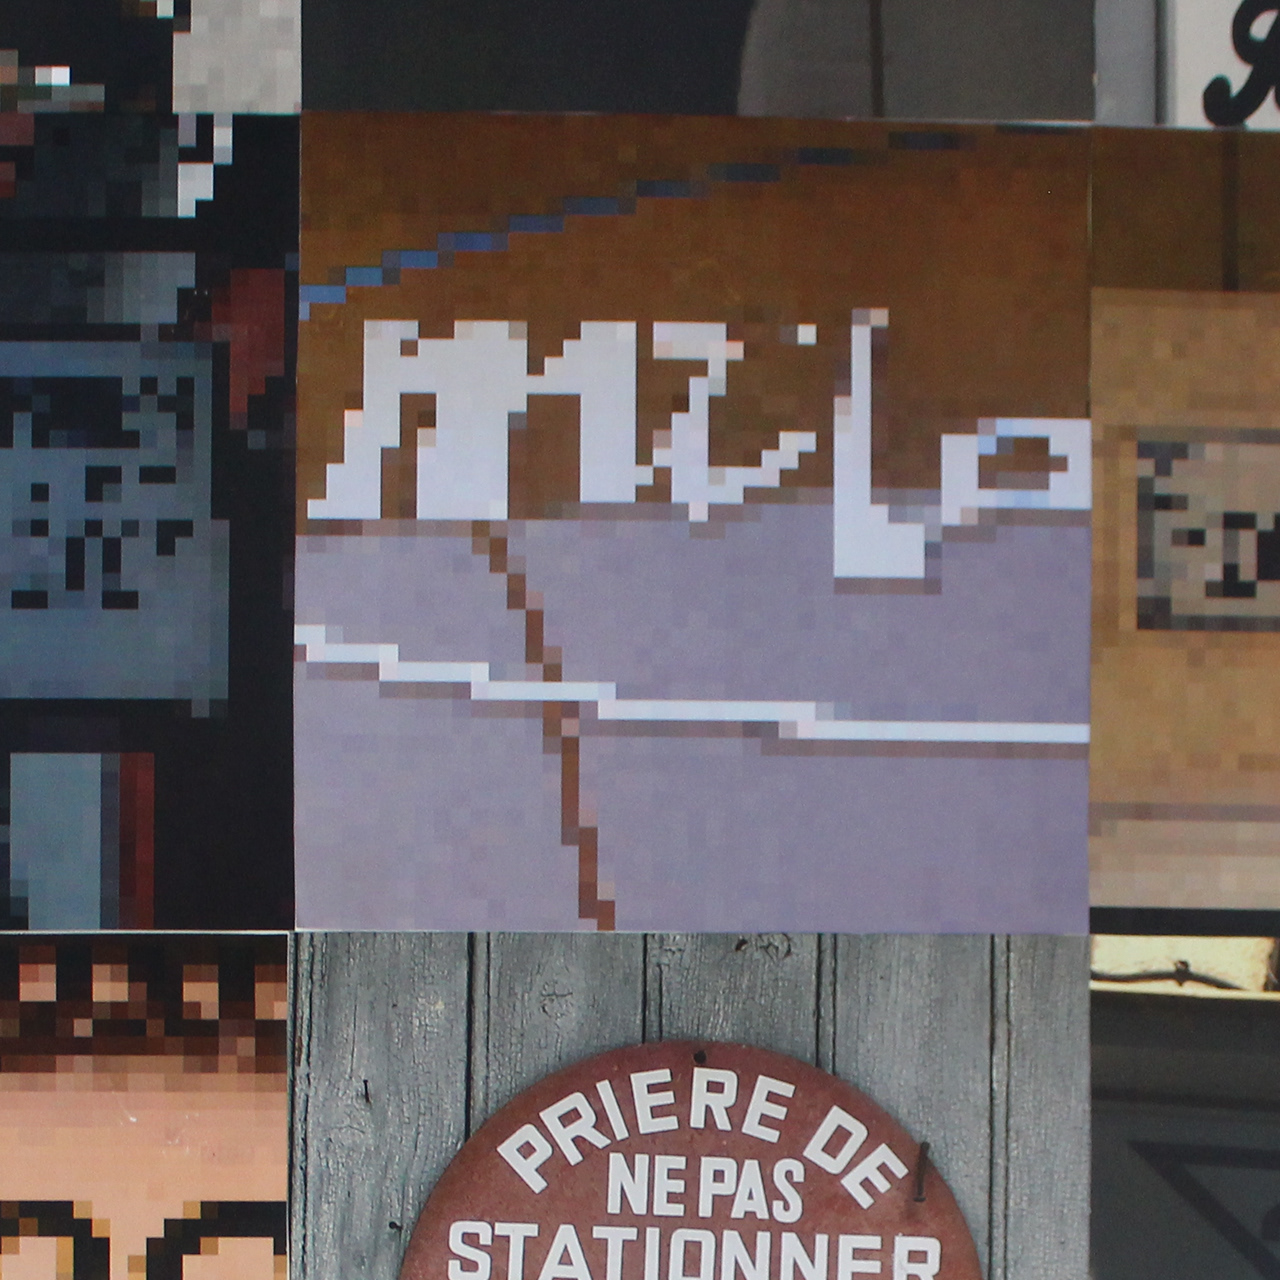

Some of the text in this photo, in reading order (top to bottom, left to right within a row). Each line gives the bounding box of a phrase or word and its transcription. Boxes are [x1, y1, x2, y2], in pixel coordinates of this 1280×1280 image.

[495, 1066, 909, 1210] PRIERE DE
[606, 1152, 805, 1223] NE PAS
